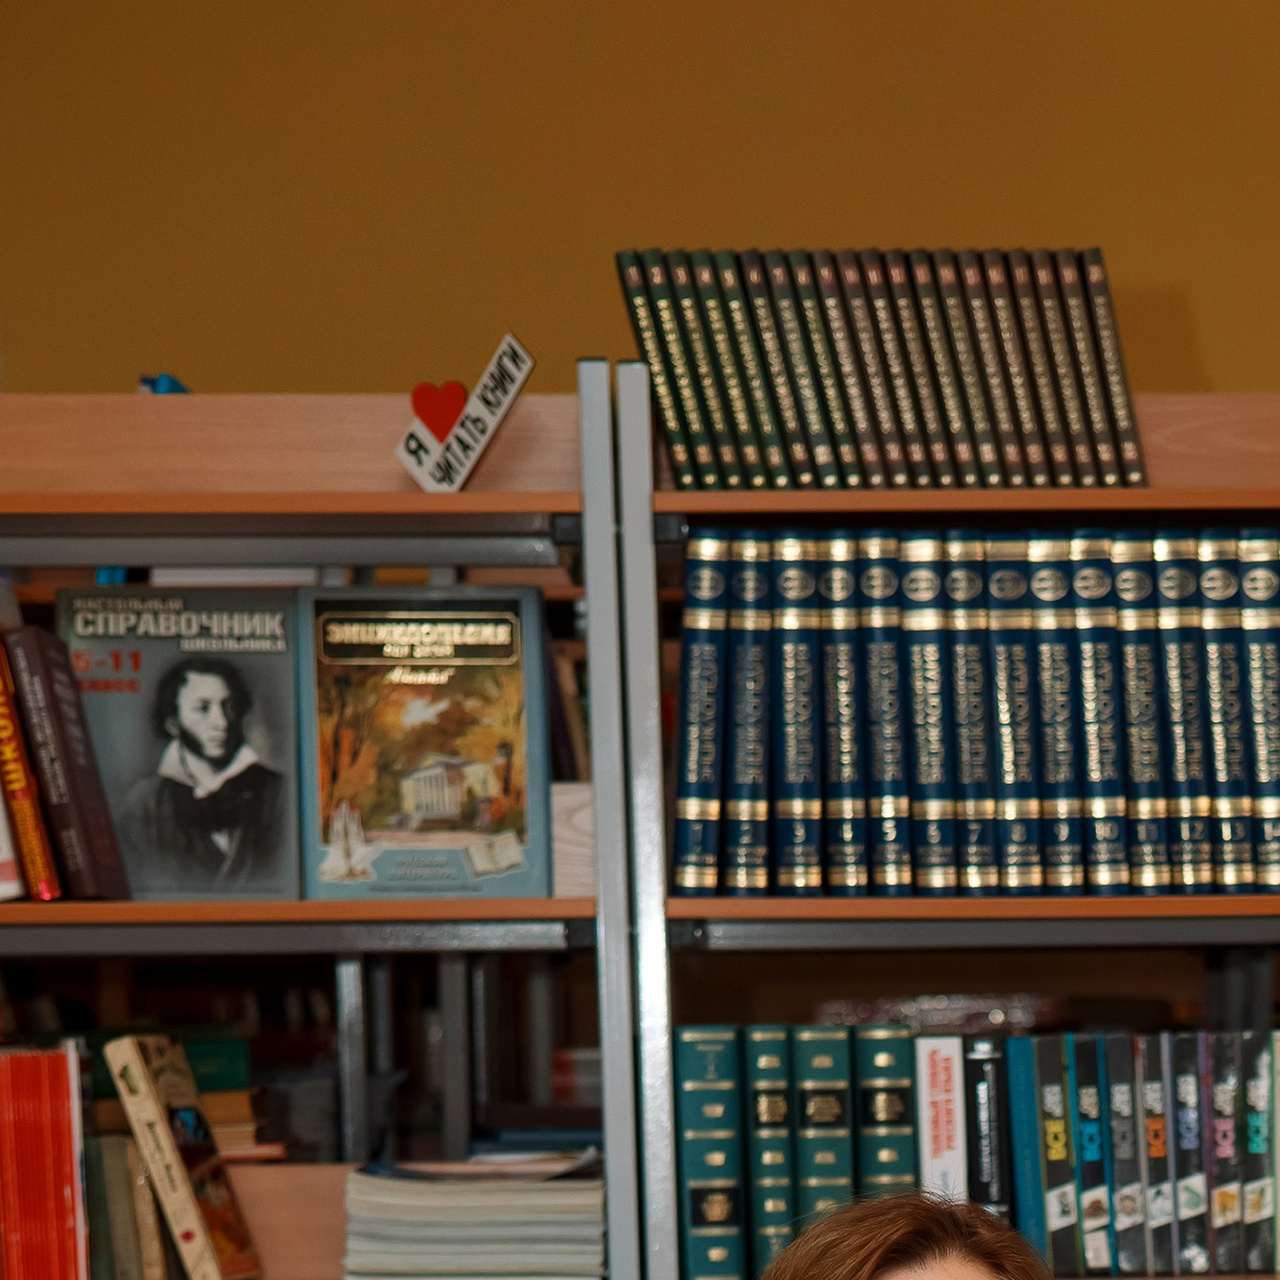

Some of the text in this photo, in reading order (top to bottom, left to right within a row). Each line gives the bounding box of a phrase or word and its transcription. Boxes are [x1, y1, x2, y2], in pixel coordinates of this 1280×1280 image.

[428, 338, 528, 489] ЧИТАТЬ КНИГИ
[402, 429, 432, 469] Я
[74, 611, 286, 637] СПРАВОЧНИК
[1045, 1120, 1067, 1161] ВСЕ
[1080, 1121, 1101, 1162] ВСЕ
